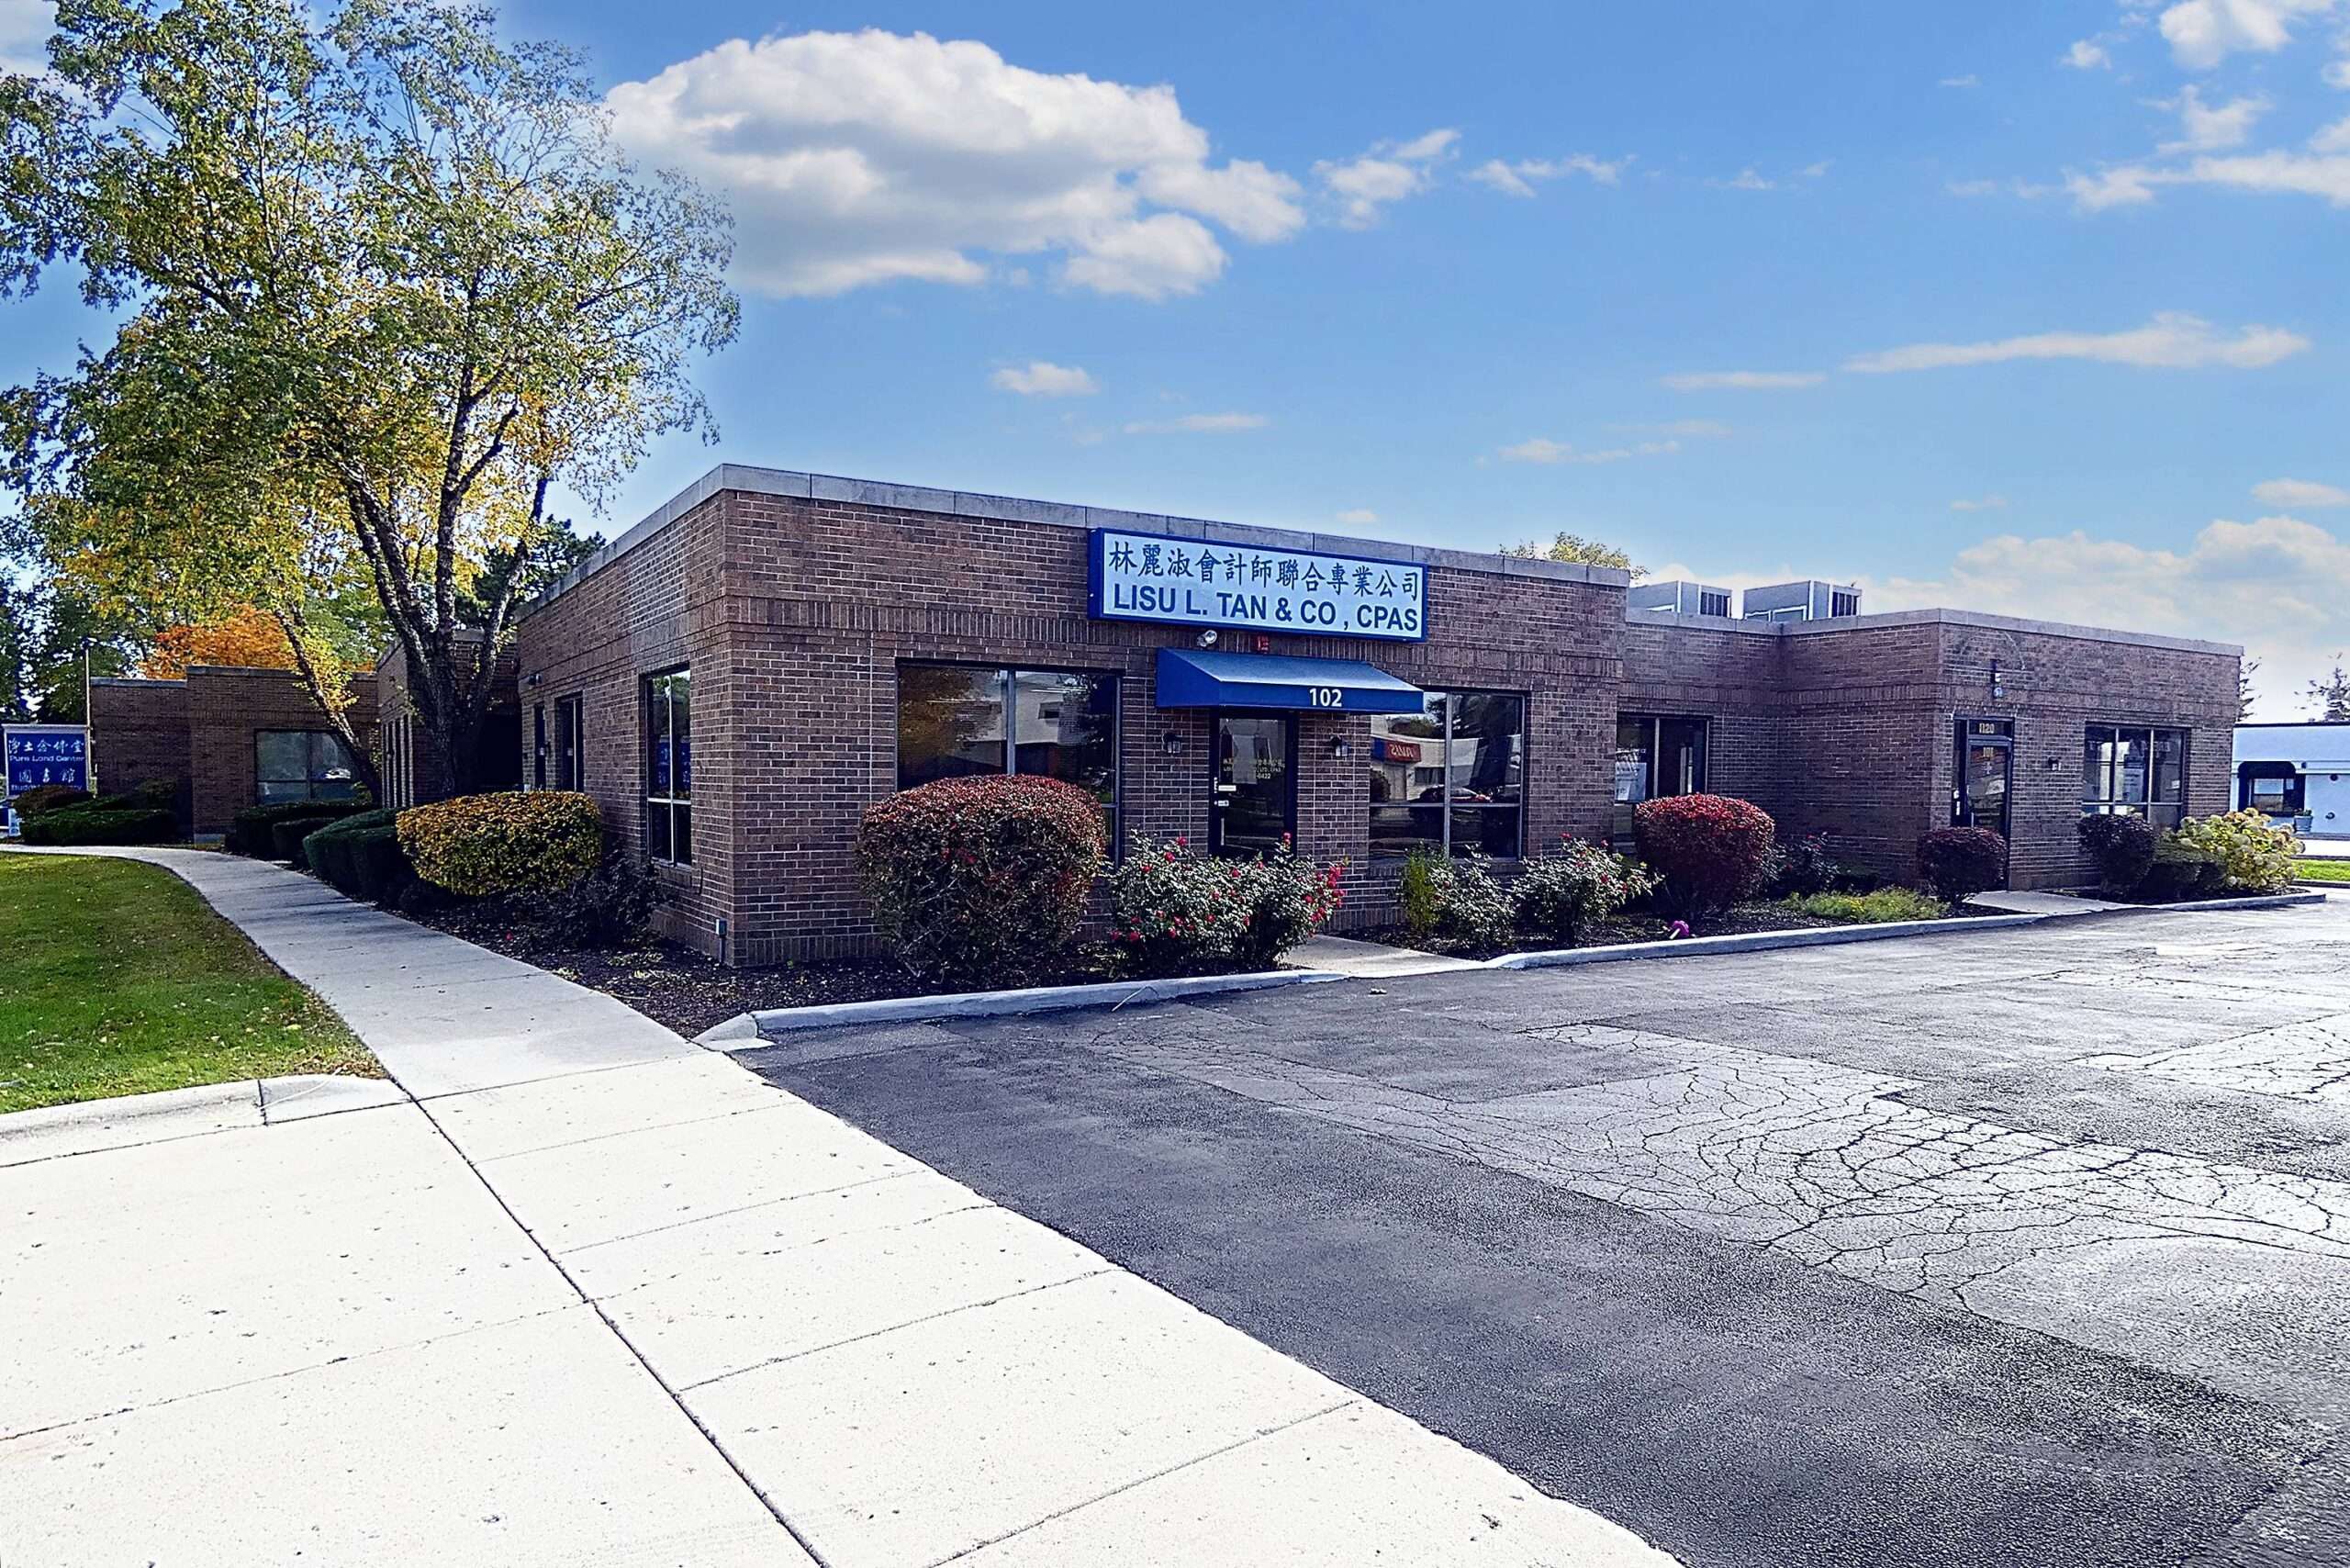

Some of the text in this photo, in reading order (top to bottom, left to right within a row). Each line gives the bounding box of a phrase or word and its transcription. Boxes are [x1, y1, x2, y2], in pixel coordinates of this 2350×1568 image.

[1109, 541, 1418, 602] 林麗淑會計師聯合專業公司
[1113, 583, 1176, 613] LISU
[1186, 589, 1208, 616] L.
[1216, 592, 1267, 621] TAN
[1275, 597, 1292, 622] &
[1356, 604, 1418, 632] CPAS
[1309, 688, 1342, 707] 102
